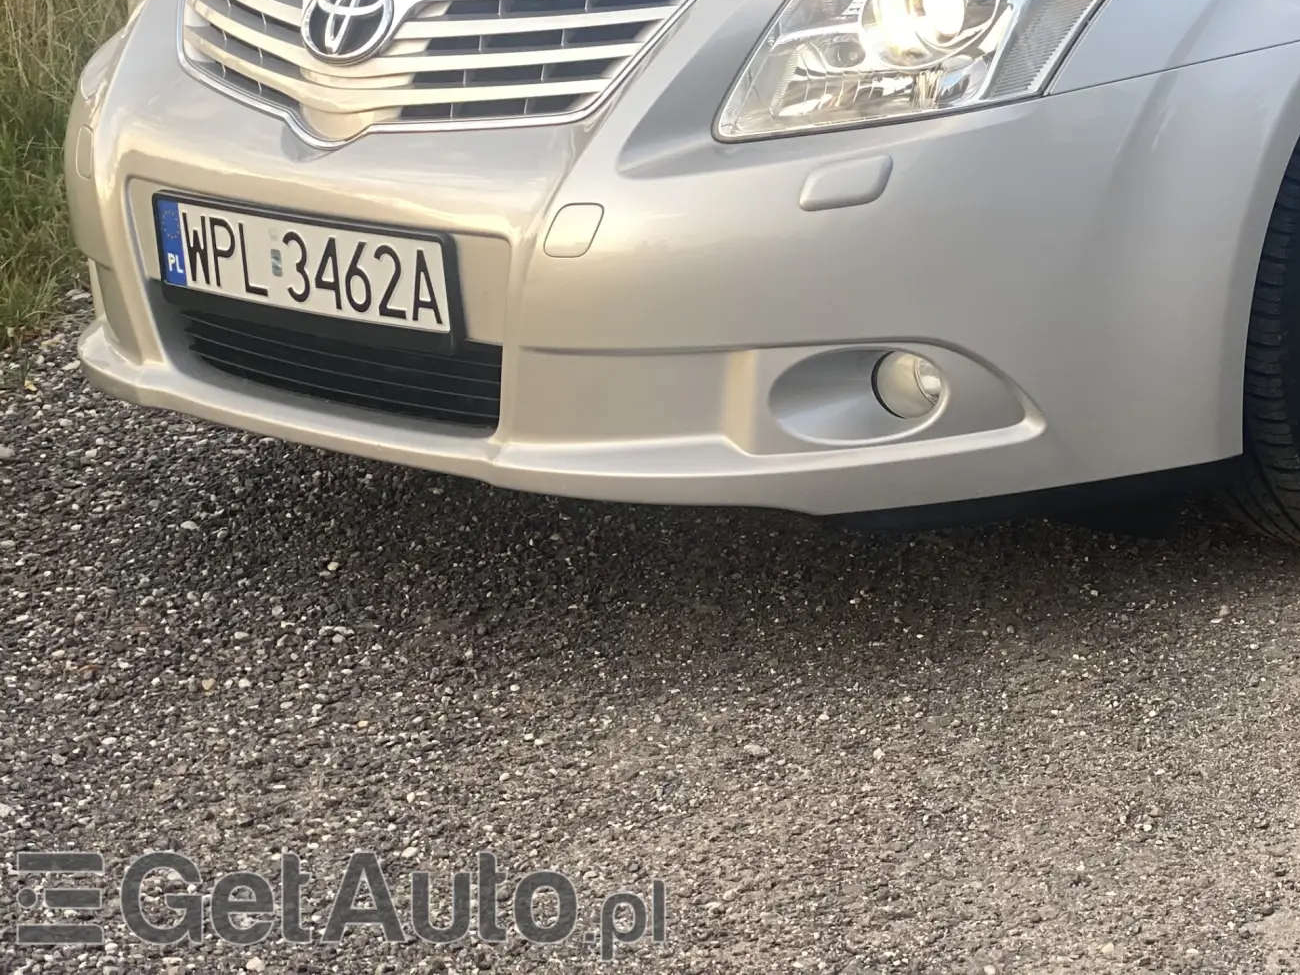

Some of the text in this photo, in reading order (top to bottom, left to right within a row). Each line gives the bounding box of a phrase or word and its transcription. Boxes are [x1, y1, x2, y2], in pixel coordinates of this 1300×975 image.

[167, 251, 184, 274] PL
[182, 211, 443, 325] WPL 3462A
